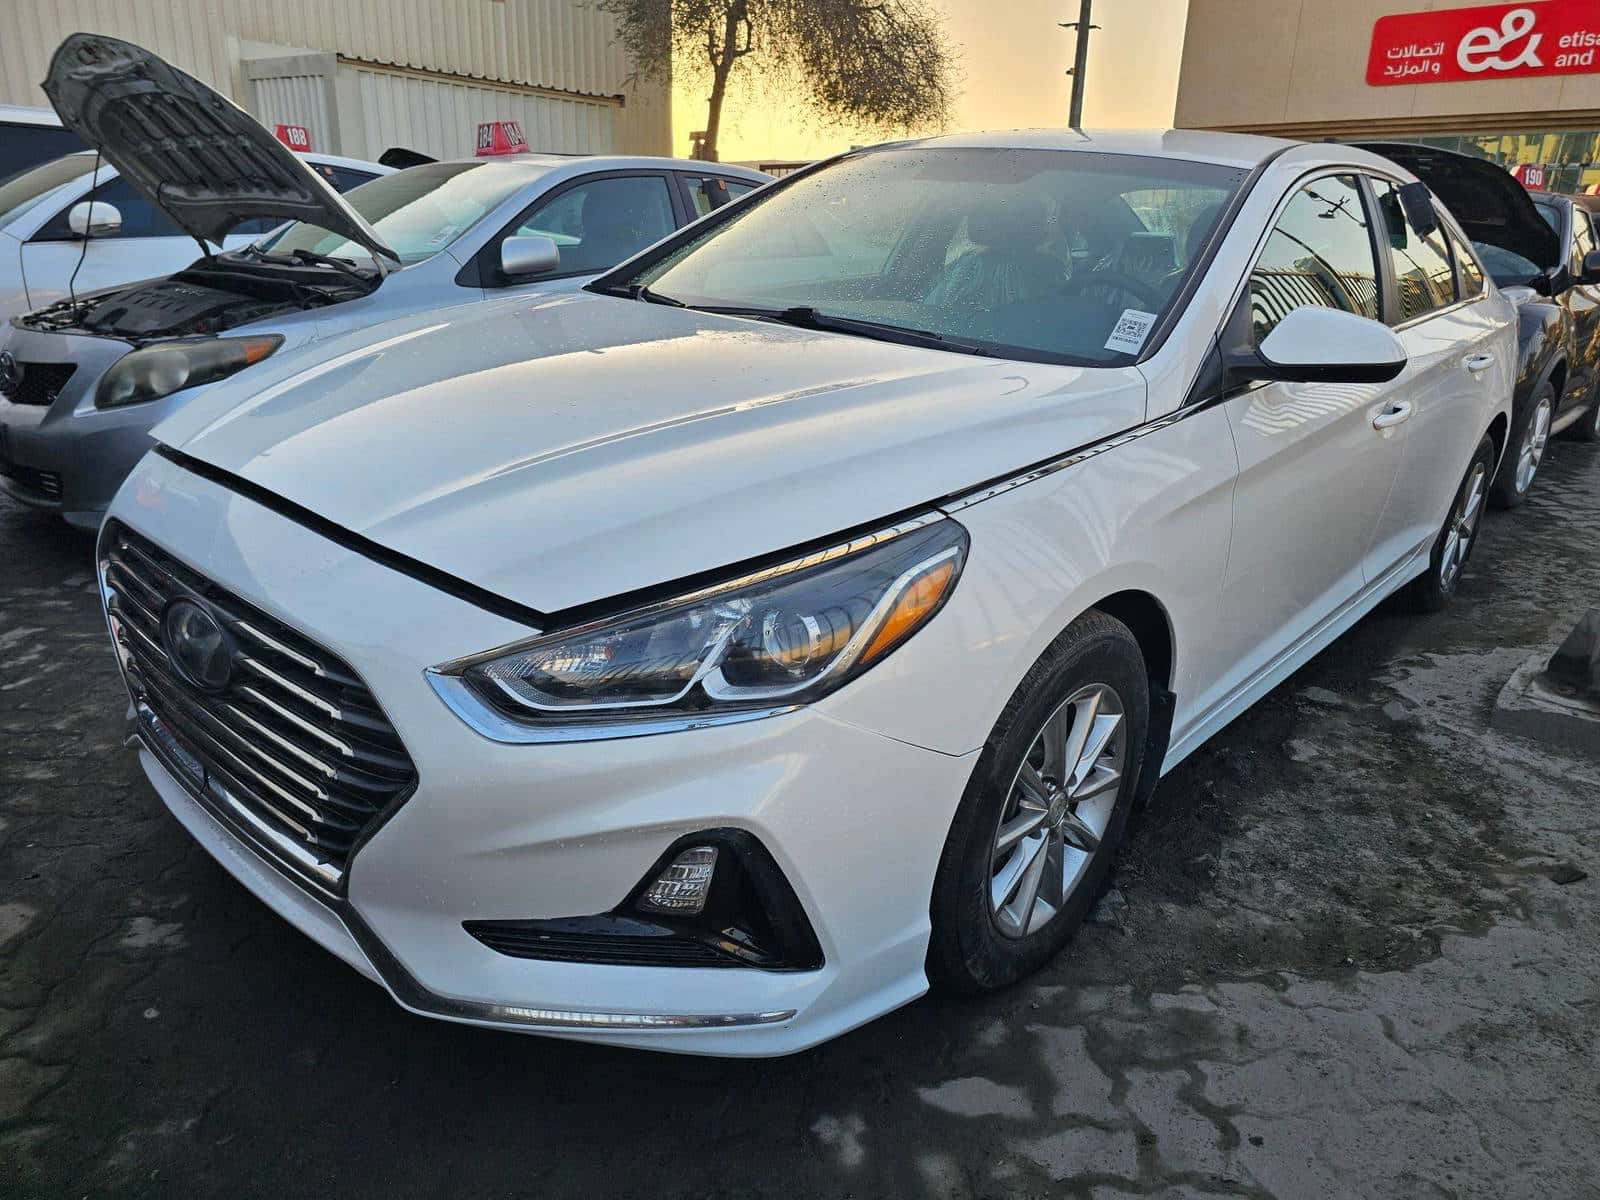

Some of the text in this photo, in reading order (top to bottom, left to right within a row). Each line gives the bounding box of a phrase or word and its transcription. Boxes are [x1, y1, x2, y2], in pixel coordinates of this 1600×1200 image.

[1387, 42, 1444, 59] اتصالات
[1554, 49, 1594, 67] and
[287, 127, 307, 146] 188
[480, 124, 494, 148] 184
[1525, 168, 1543, 186] 190
